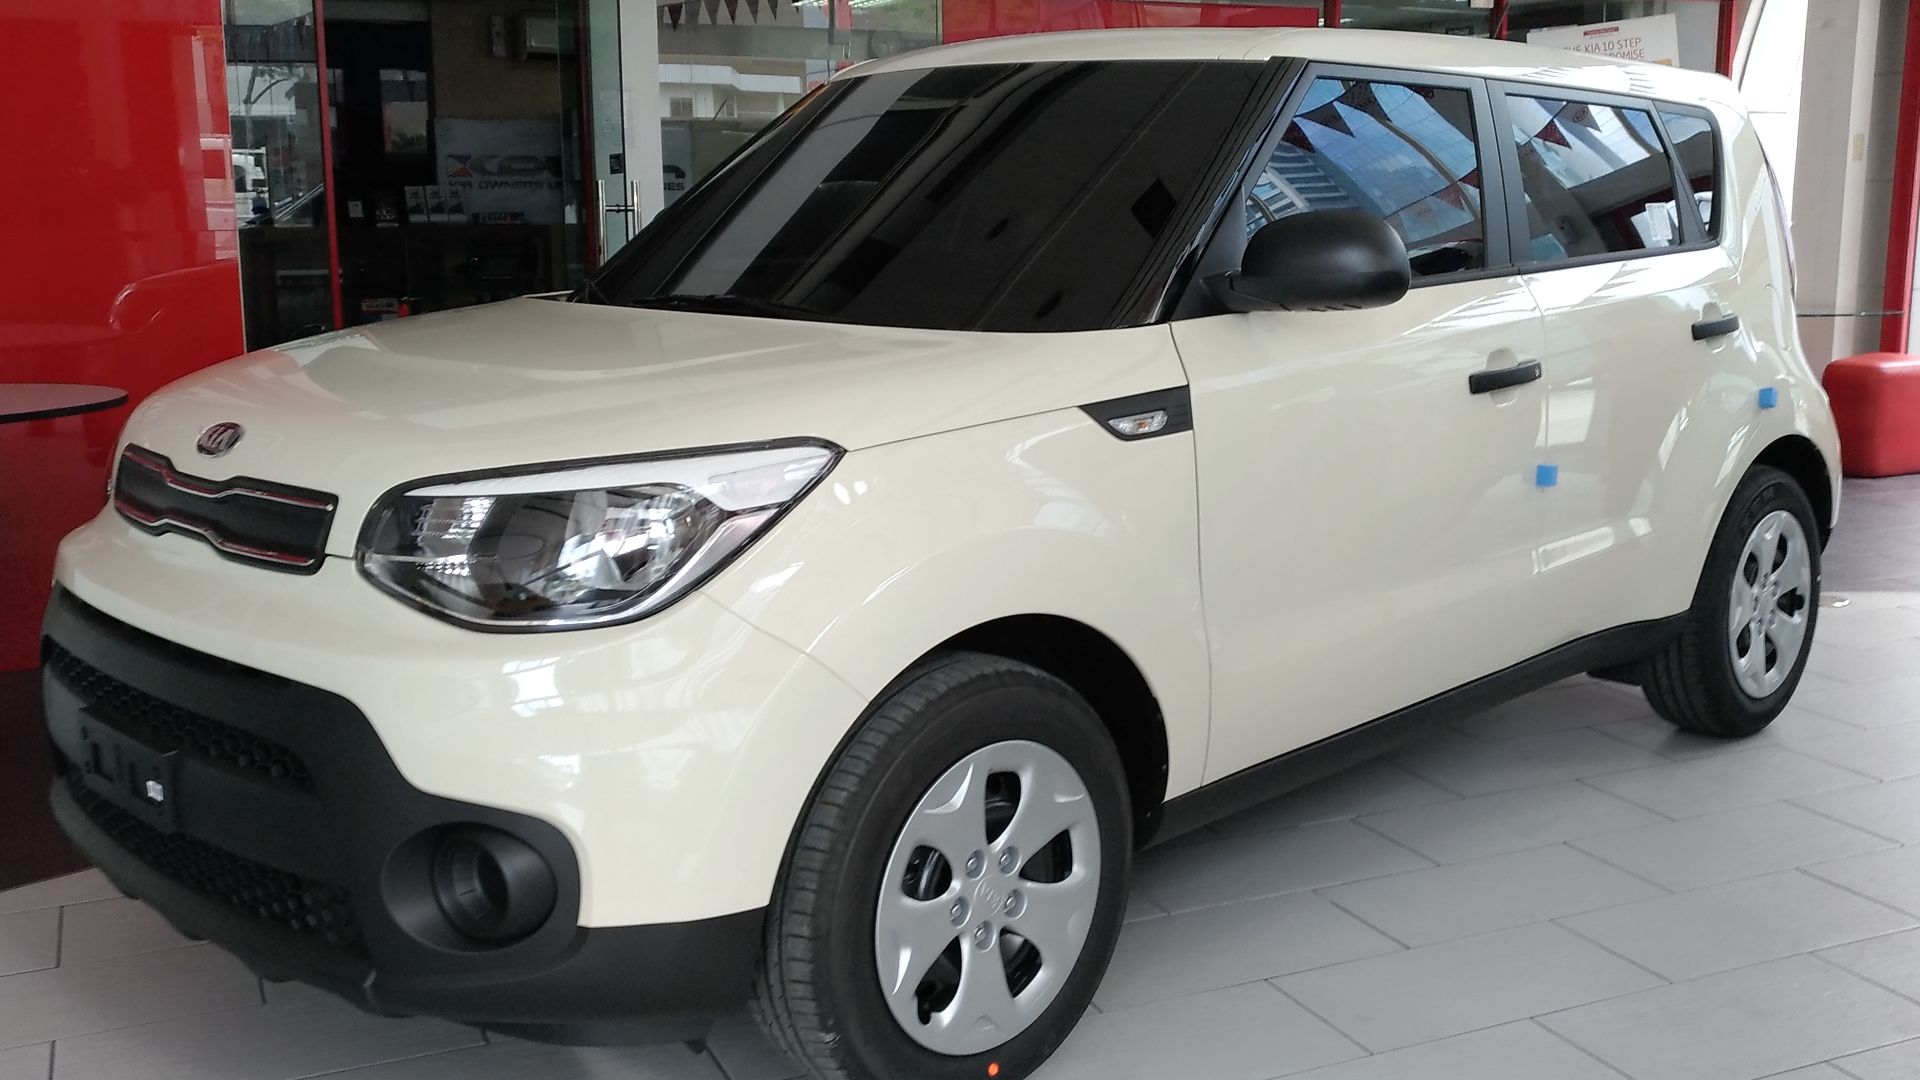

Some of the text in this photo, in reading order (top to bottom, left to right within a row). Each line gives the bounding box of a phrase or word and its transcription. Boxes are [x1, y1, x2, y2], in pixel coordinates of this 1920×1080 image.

[1584, 43, 1601, 54] KIA
[1602, 41, 1615, 52] 10
[1617, 37, 1642, 50] STEP
[478, 180, 545, 191] OWNERS
[199, 423, 237, 452] KIA
